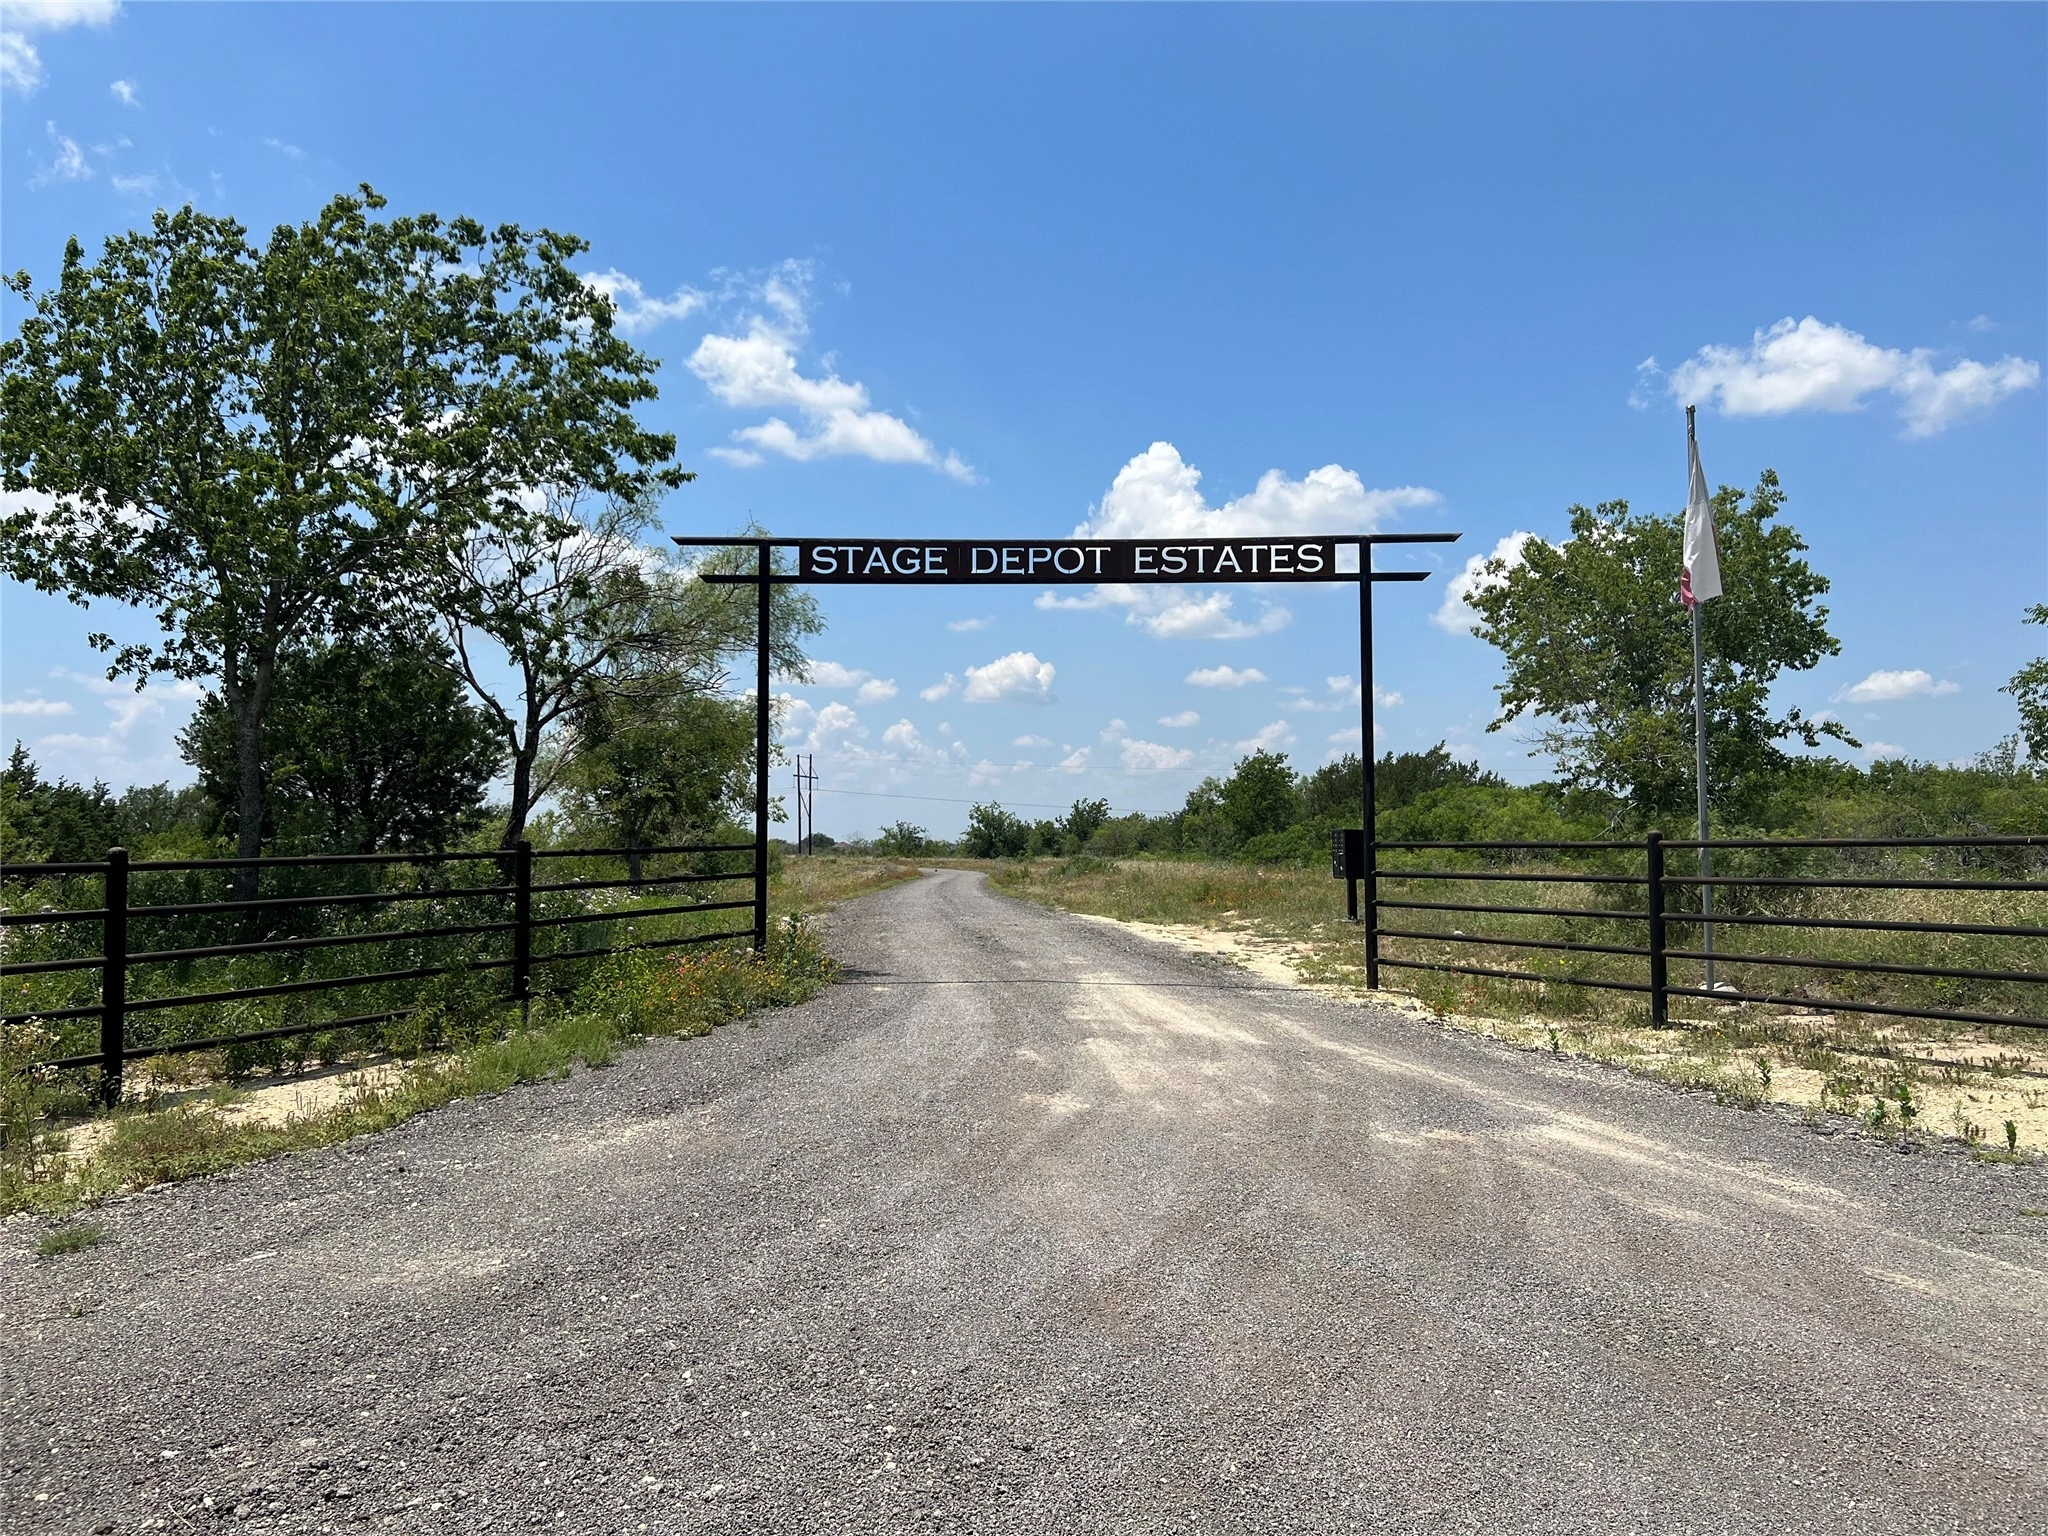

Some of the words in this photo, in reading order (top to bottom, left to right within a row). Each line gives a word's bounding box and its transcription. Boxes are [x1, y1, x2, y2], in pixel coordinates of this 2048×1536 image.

[811, 546, 948, 575] STAGE
[970, 546, 1111, 575] DEPOT
[1134, 543, 1324, 575] ESTATES
